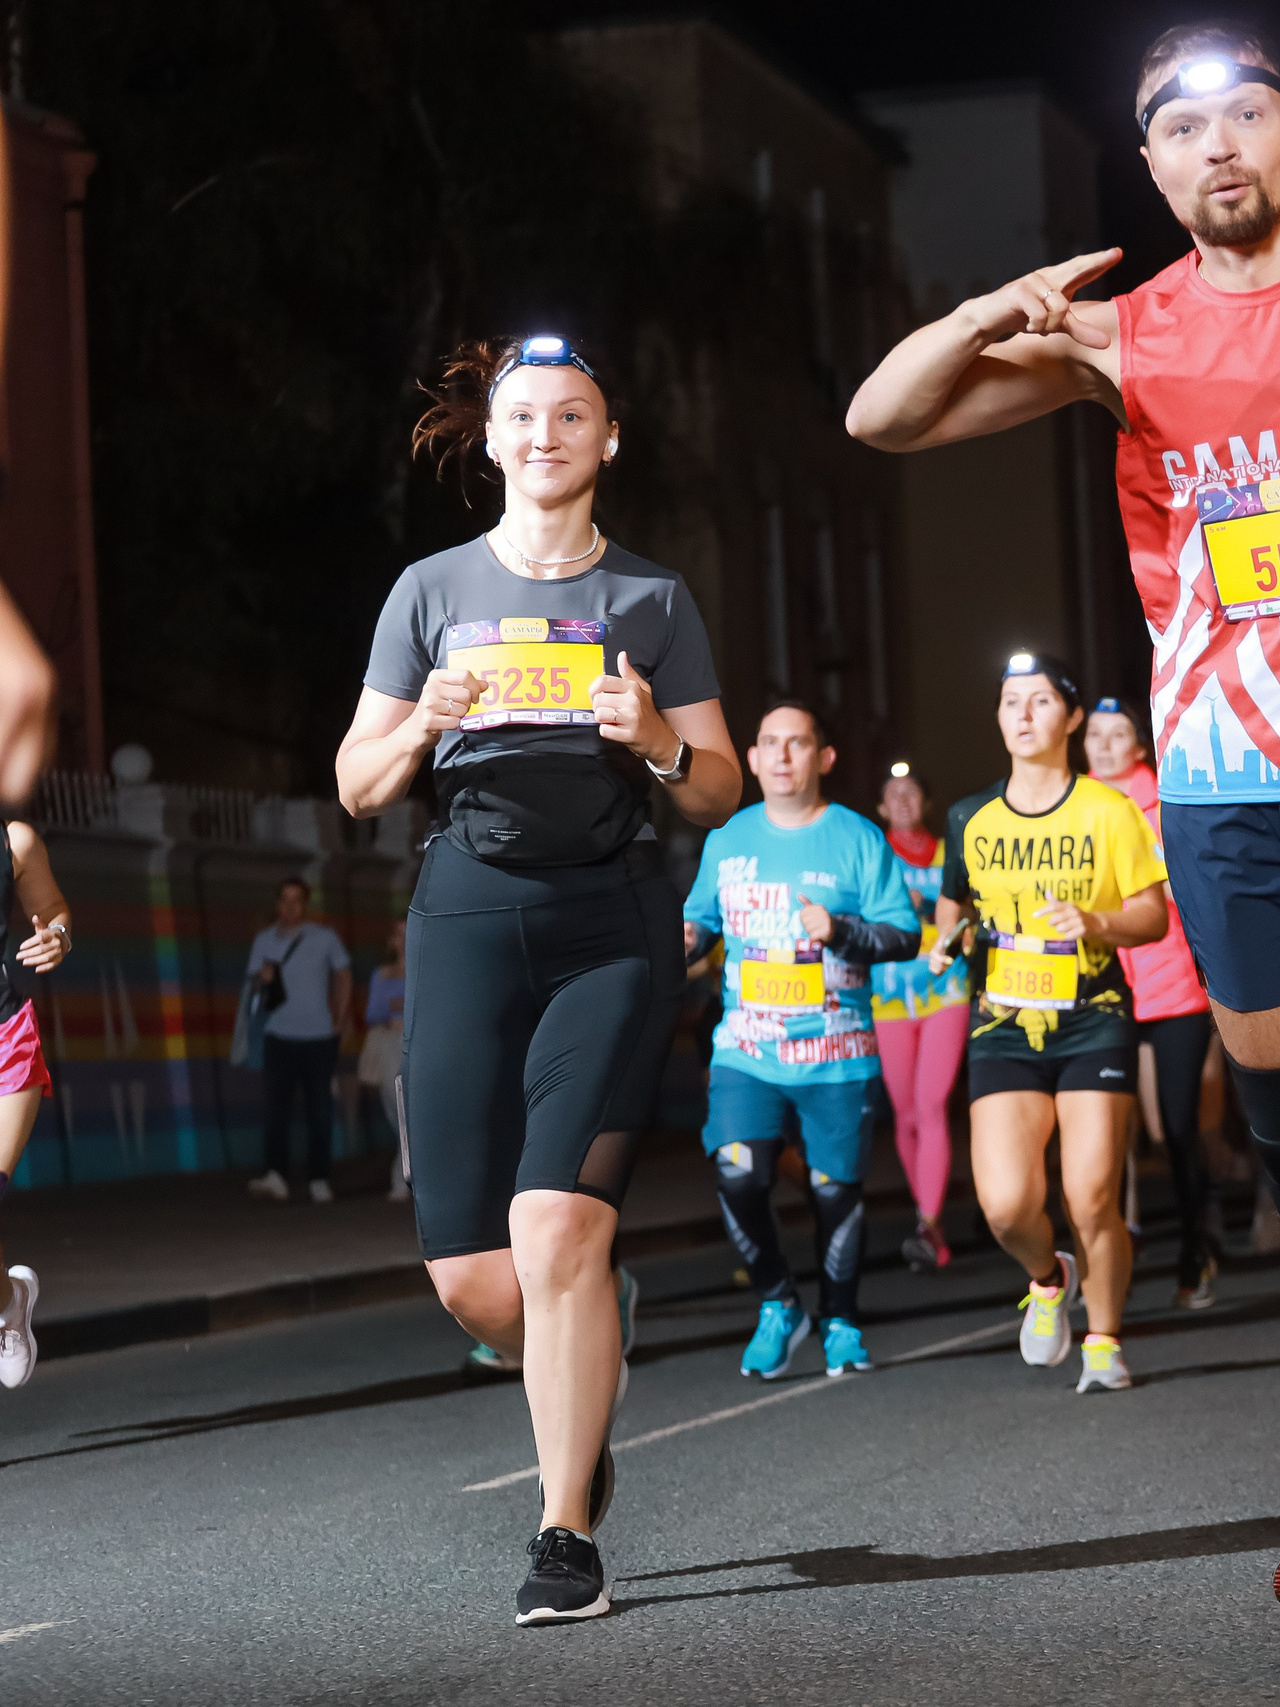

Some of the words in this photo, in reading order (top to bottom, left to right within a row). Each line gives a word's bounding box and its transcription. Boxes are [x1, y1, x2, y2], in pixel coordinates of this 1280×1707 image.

[481, 667, 571, 706] 5235
[974, 835, 1095, 870] SAMARA
[1035, 878, 1094, 902] NIGHT
[755, 977, 807, 1001] 5070
[1003, 968, 1053, 996] 5188
